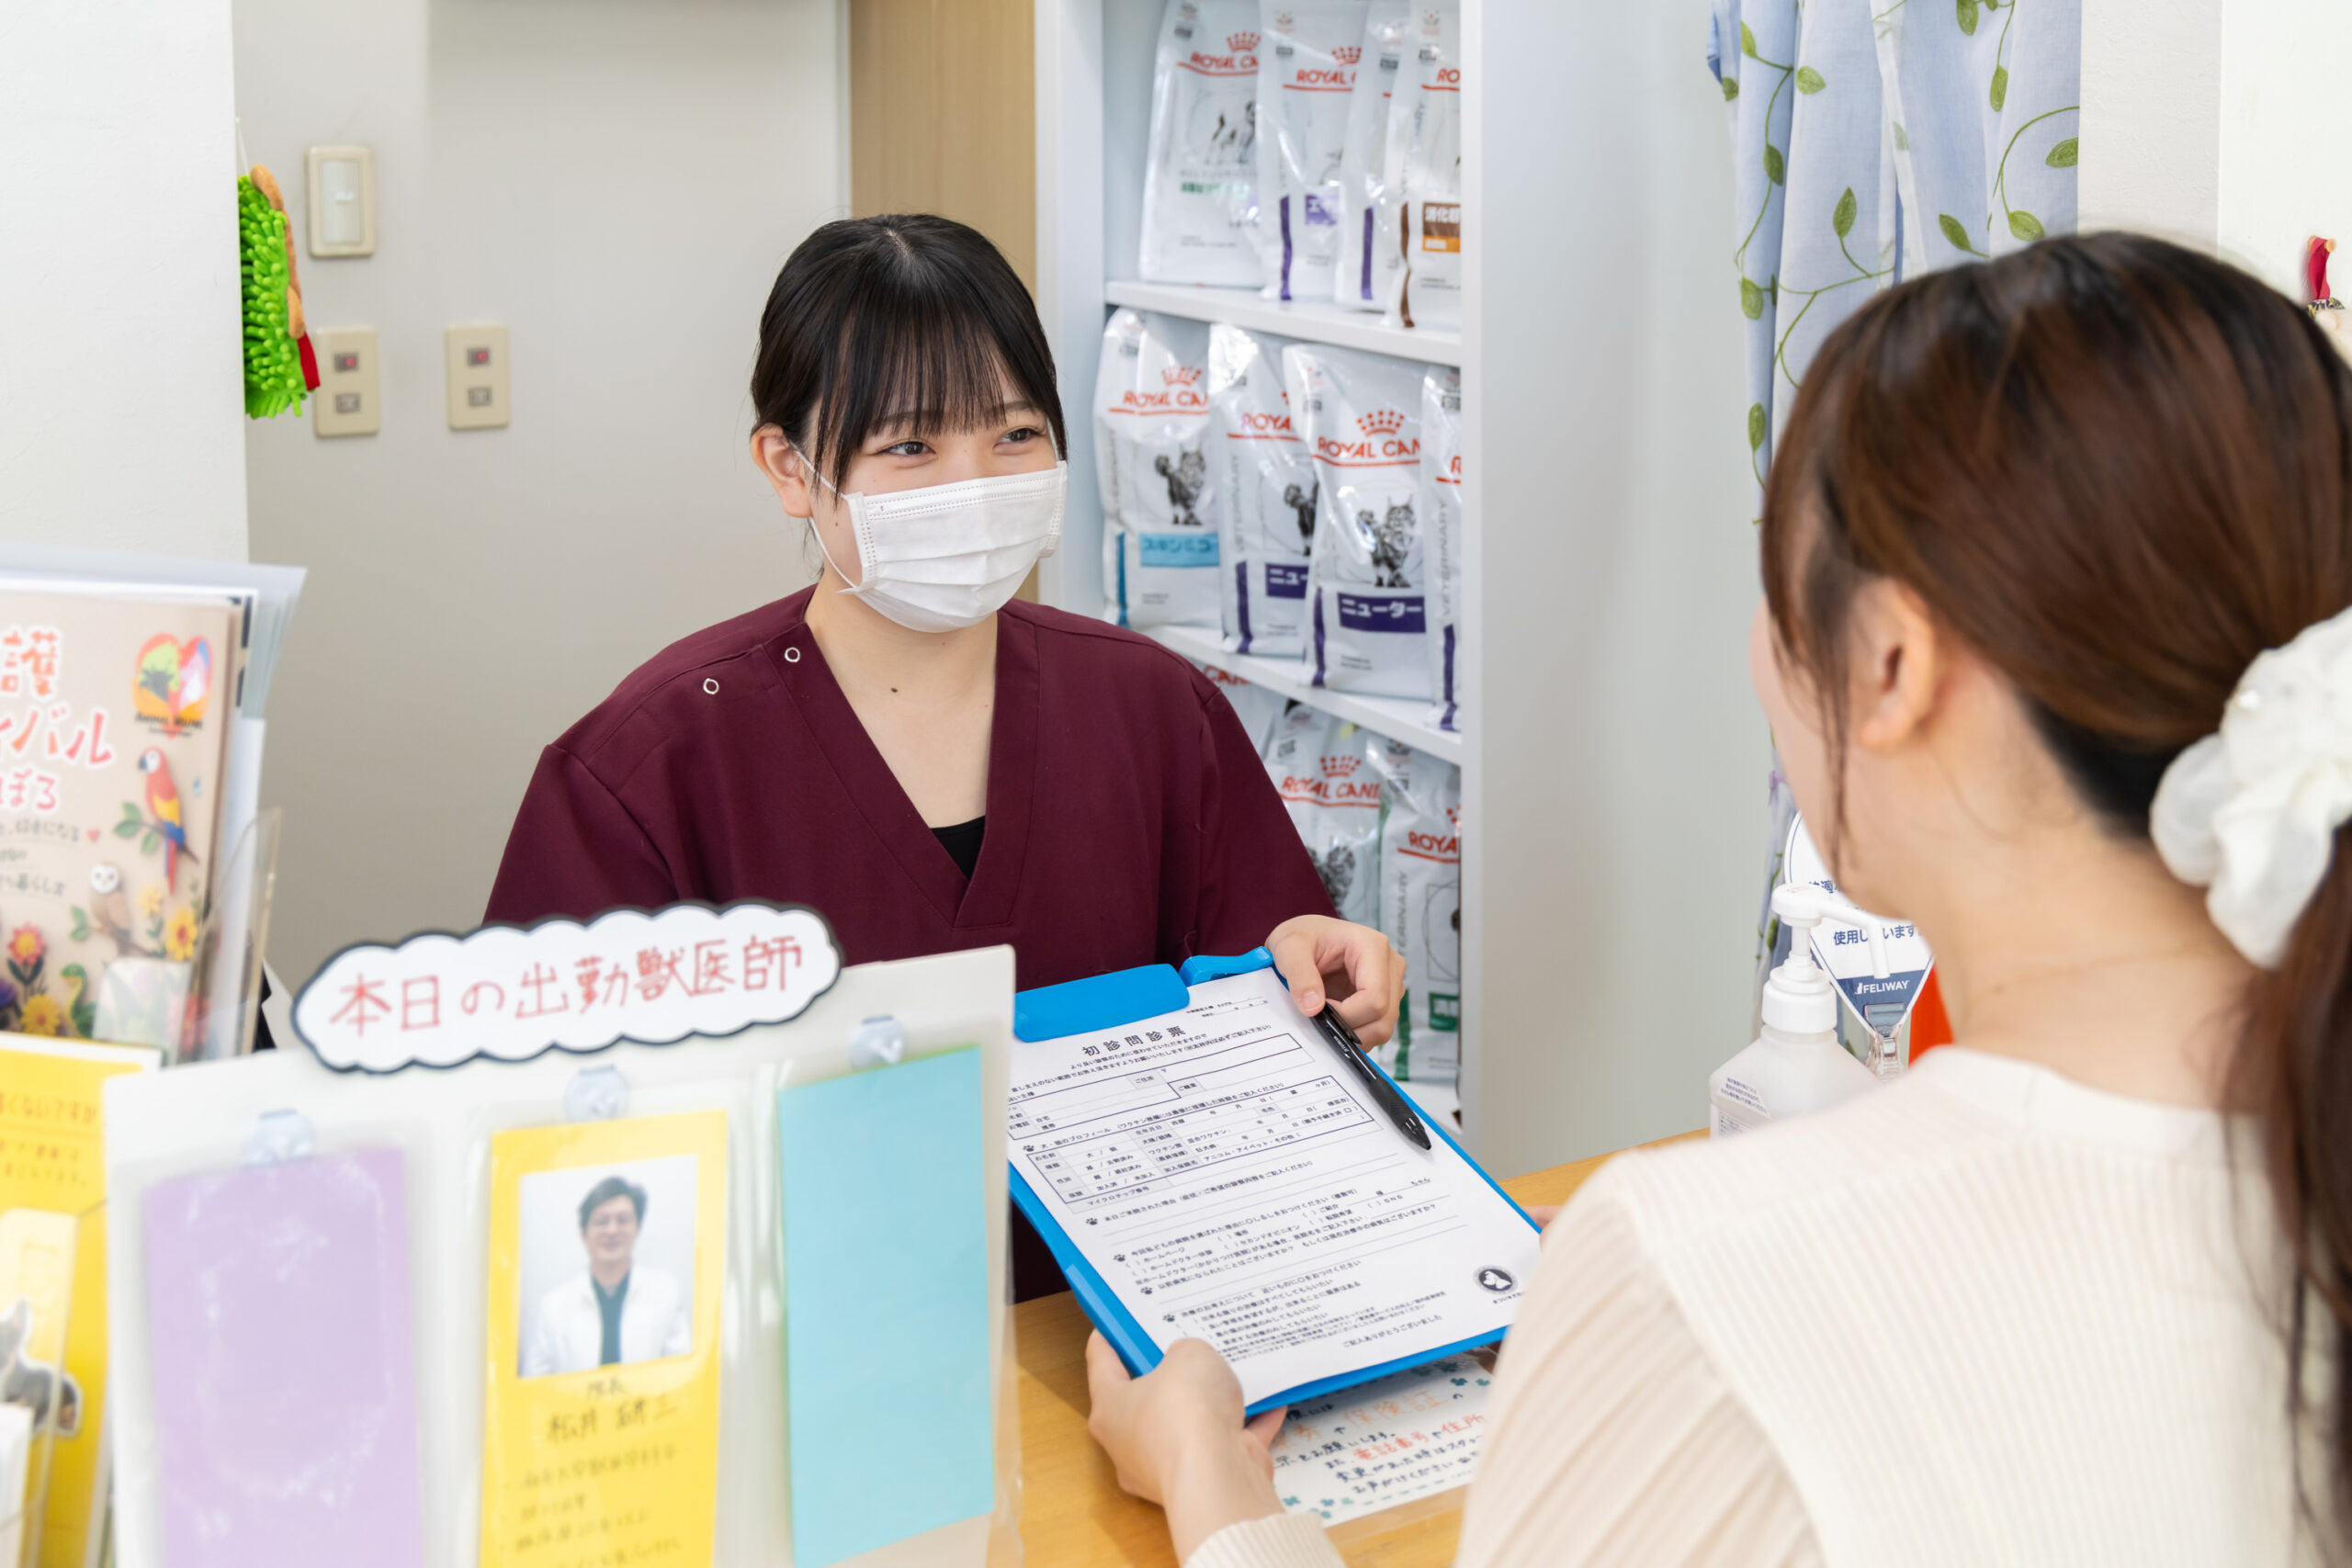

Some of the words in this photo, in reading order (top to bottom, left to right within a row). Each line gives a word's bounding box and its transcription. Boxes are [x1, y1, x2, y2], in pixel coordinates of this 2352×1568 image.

[1190, 51, 1236, 70] ROYAL
[1295, 68, 1347, 85] ROYAL
[1123, 390, 1171, 408] ROYAL
[1317, 436, 1375, 458] ROYAL
[1340, 597, 1423, 618] ニューター
[1282, 776, 1330, 799] ROYAL
[1833, 925, 1916, 946] 使用しいます
[329, 933, 803, 1037] 本日の出勤獣医師
[1863, 979, 1910, 994] FELIWAY
[1080, 1024, 1187, 1056] 初診問診票
